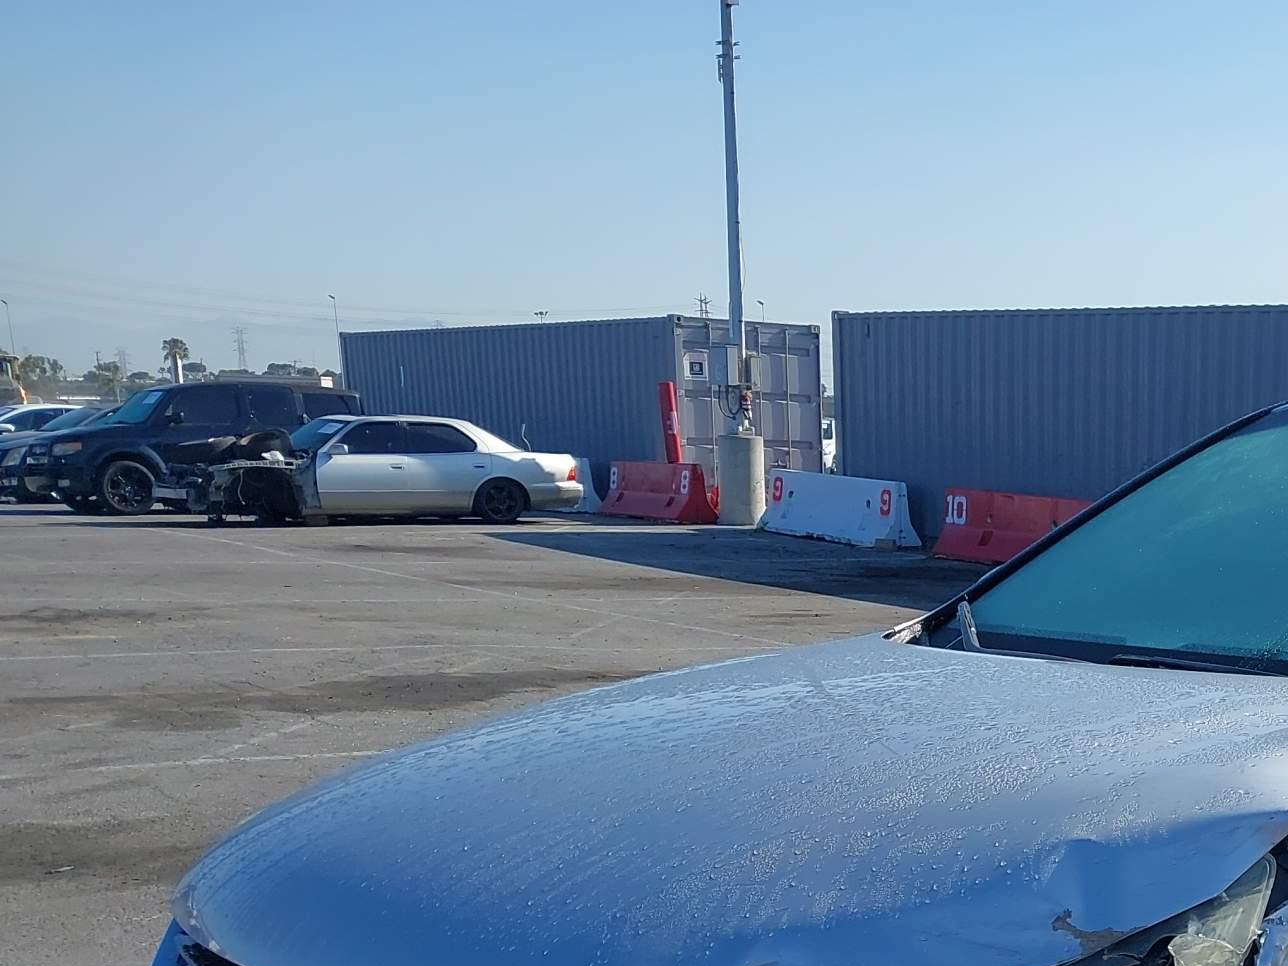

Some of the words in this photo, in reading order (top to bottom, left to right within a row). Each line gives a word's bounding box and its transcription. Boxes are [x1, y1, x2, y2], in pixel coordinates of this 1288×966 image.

[609, 466, 618, 489] 8
[680, 470, 689, 494] 8
[772, 476, 784, 502] 9
[879, 489, 892, 516] 9
[945, 494, 967, 525] 10
